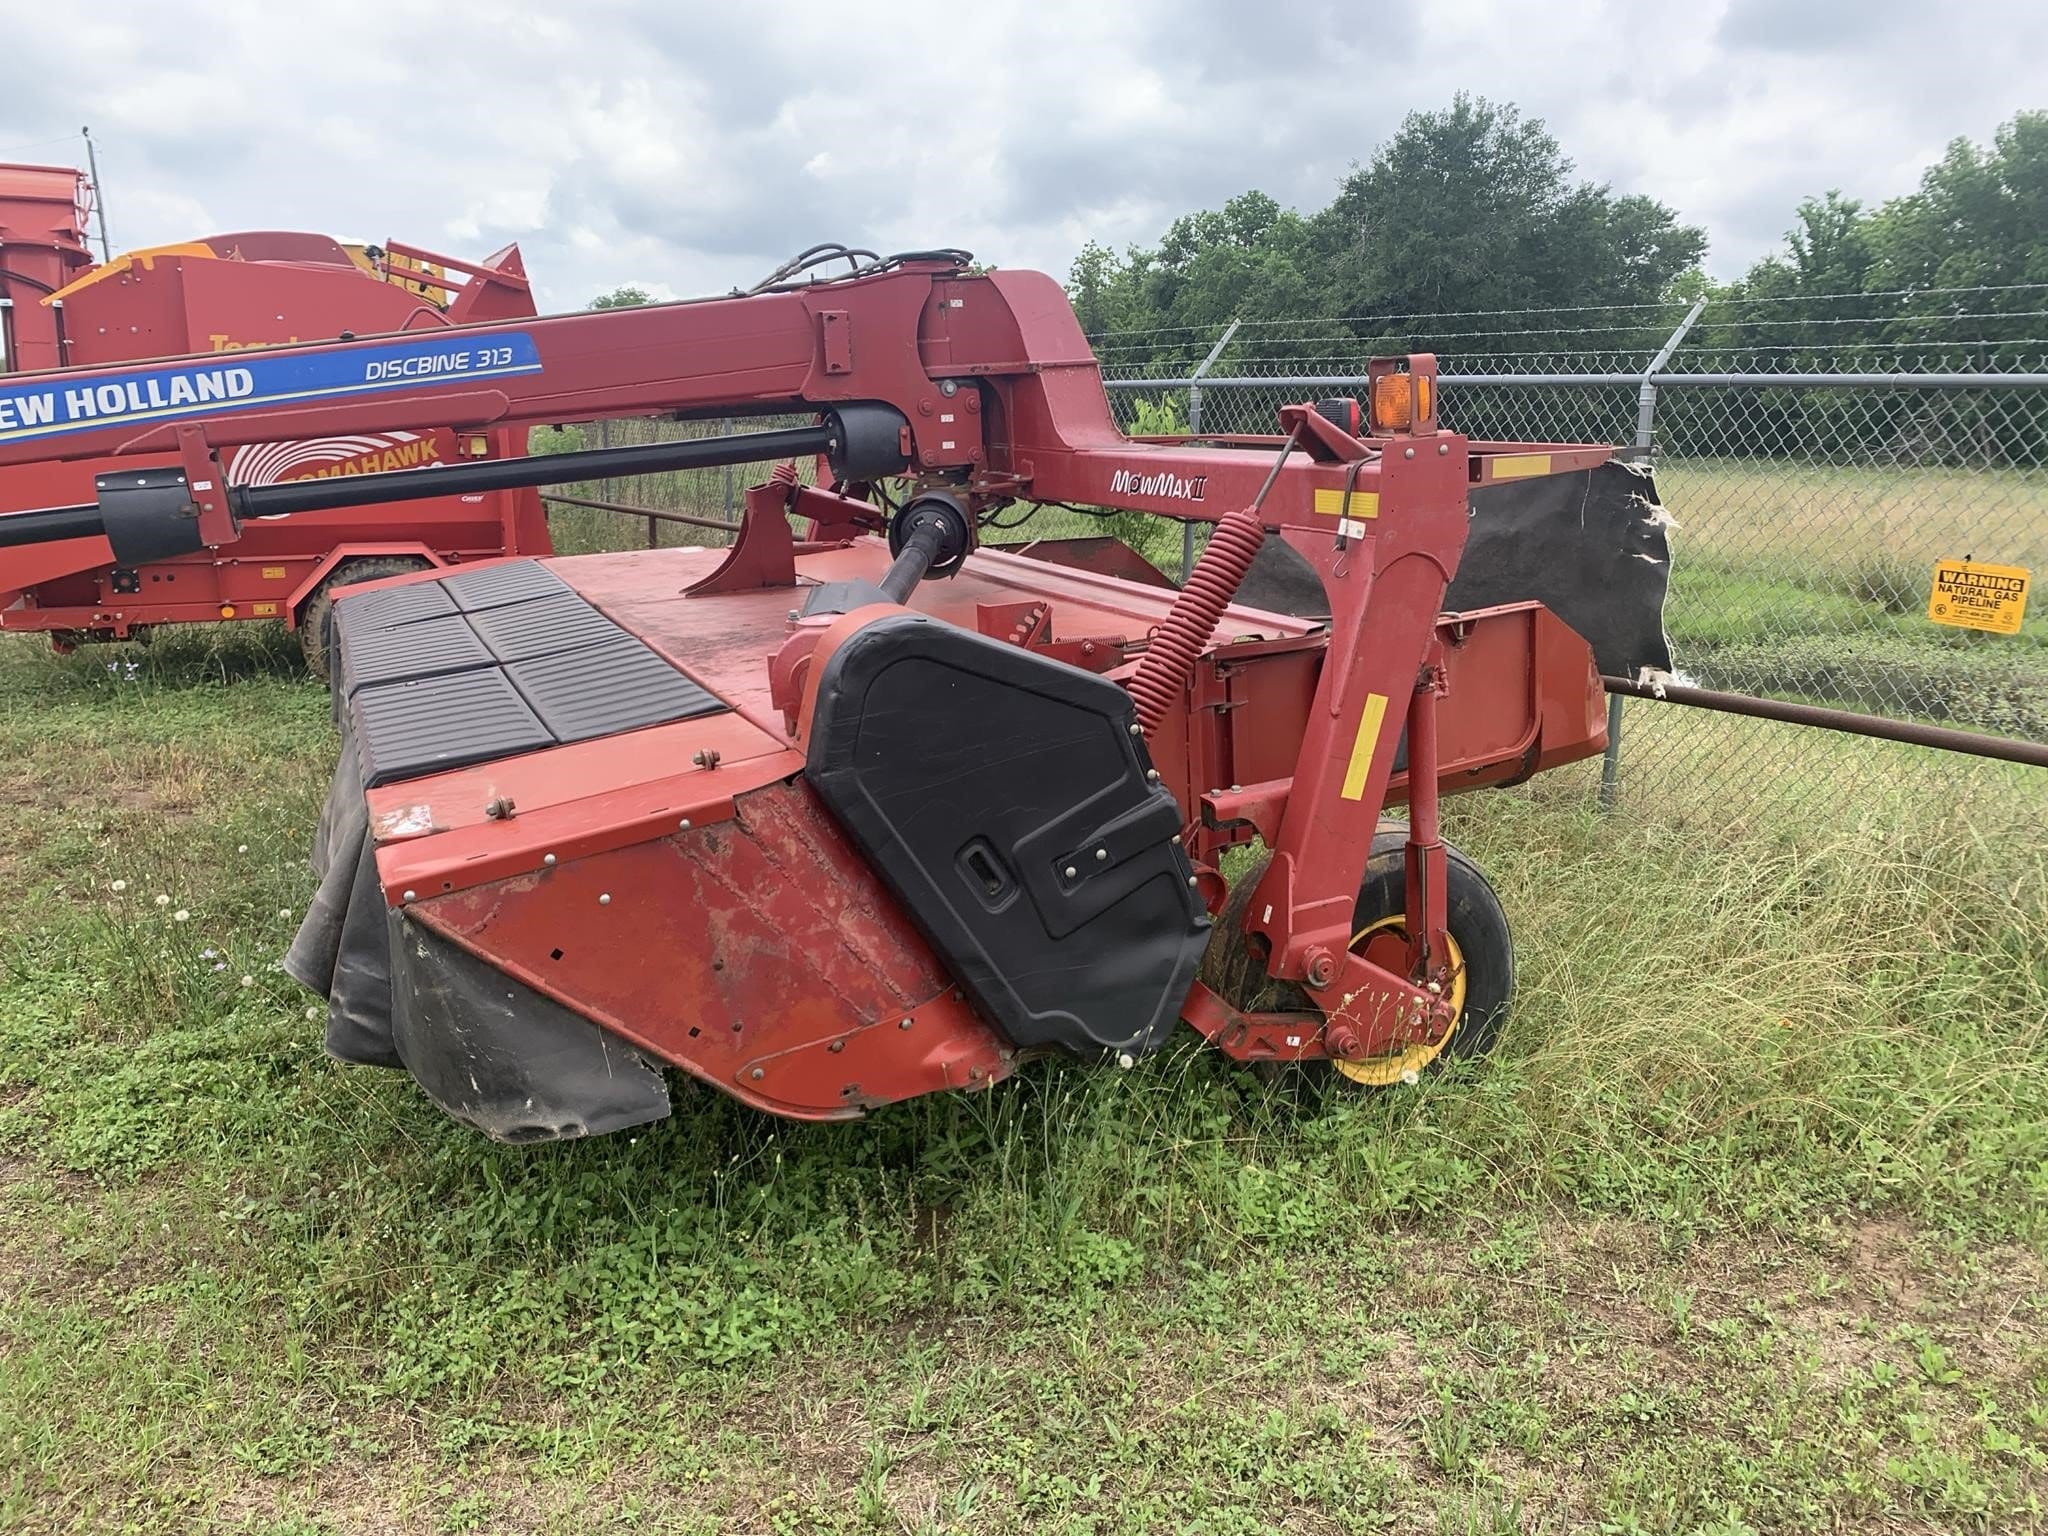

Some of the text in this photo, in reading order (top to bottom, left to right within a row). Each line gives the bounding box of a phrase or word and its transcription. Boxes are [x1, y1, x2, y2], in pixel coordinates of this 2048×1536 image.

[366, 348, 513, 381] DISCBINE 313
[0, 368, 253, 429] EW HOLLAND
[284, 438, 440, 482] MAHAWK
[1938, 584, 2018, 602] NATURAL GAS
[1942, 571, 2022, 591] WARNING
[1951, 595, 2001, 609] PIPELINE
